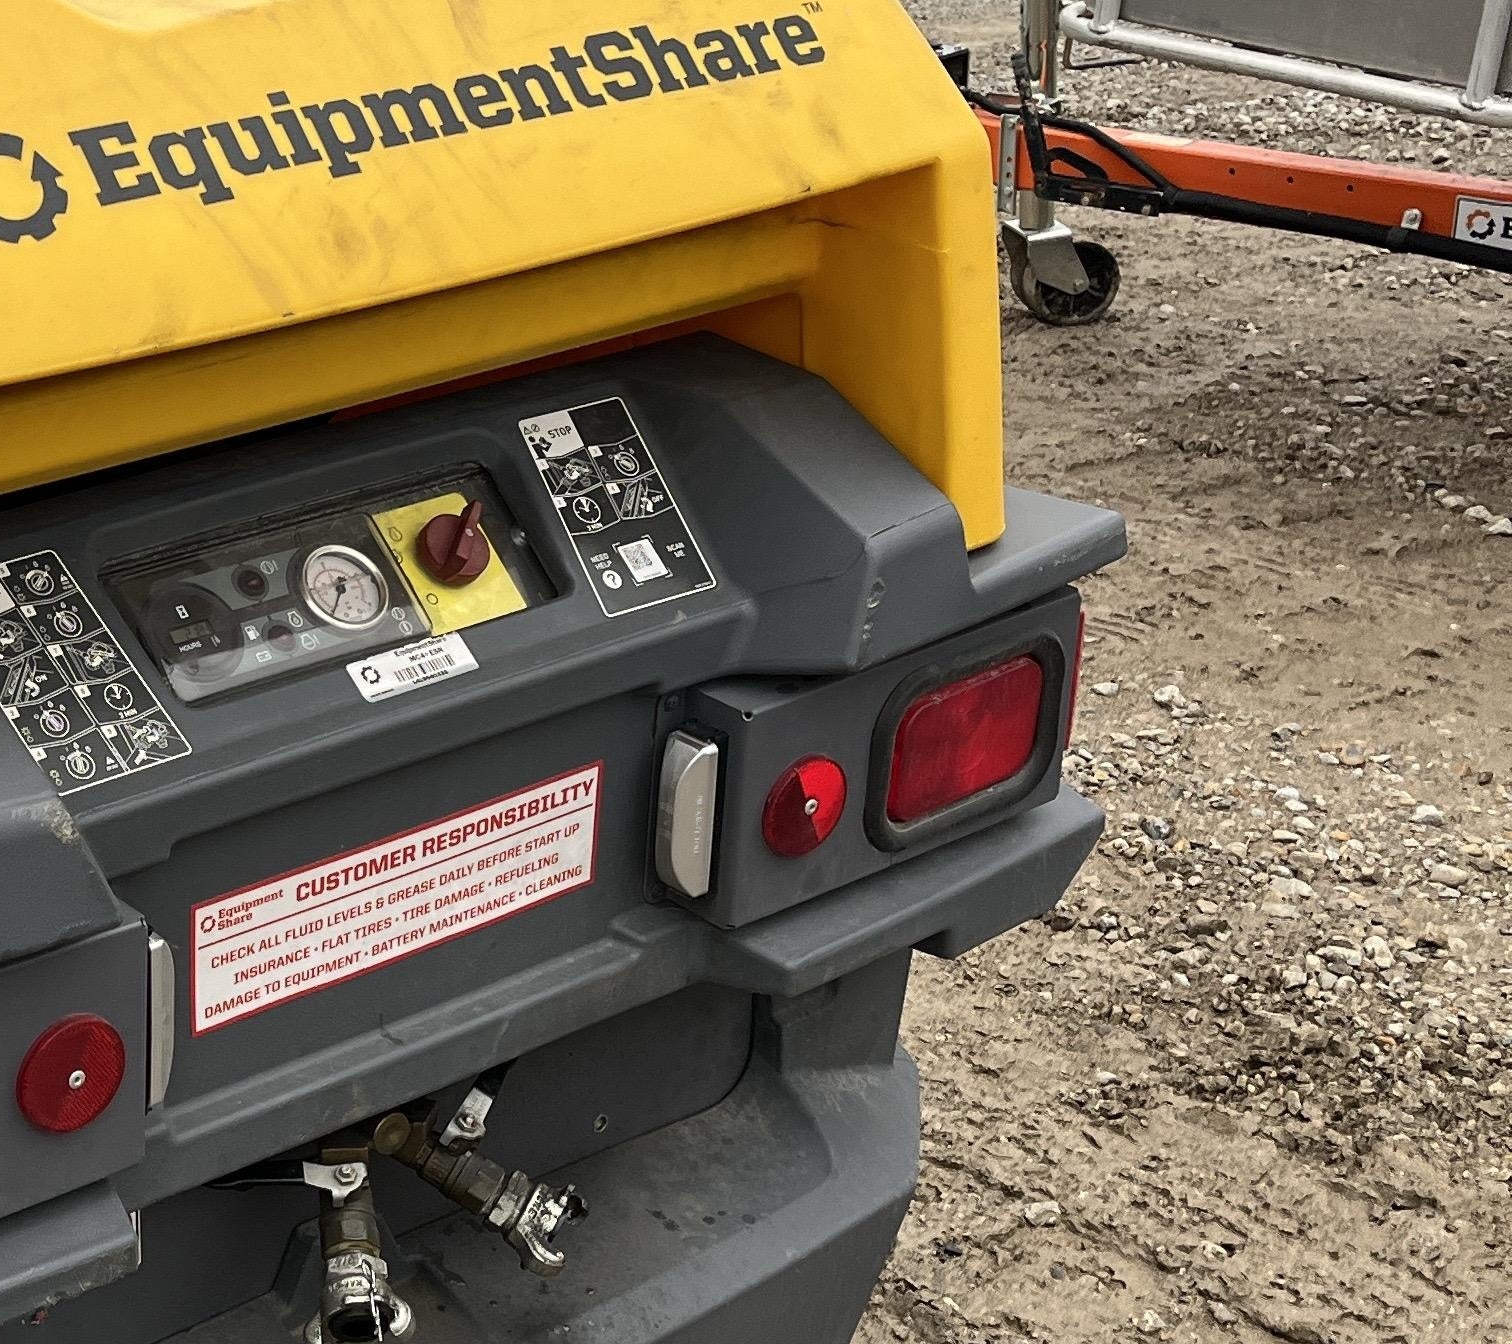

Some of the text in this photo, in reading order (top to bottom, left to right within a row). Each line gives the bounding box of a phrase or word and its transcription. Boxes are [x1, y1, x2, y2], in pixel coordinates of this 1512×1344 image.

[547, 425, 572, 439] STOP
[211, 822, 580, 969] CHECK ALL FLUID LEVELS & GREASE DAILY BEFORE START UP
[296, 778, 595, 902] CUSTOMER RESPONSIBILITY
[204, 864, 583, 1019] DAMAGE TO EQUIPMENT BATTERY MAINTENANCE CLEANING
[217, 912, 253, 931] Share
[218, 889, 284, 919] Equipment
[233, 852, 559, 985] INSURANCE FLAT TIRES TIRE DAMAGE REFUELING
